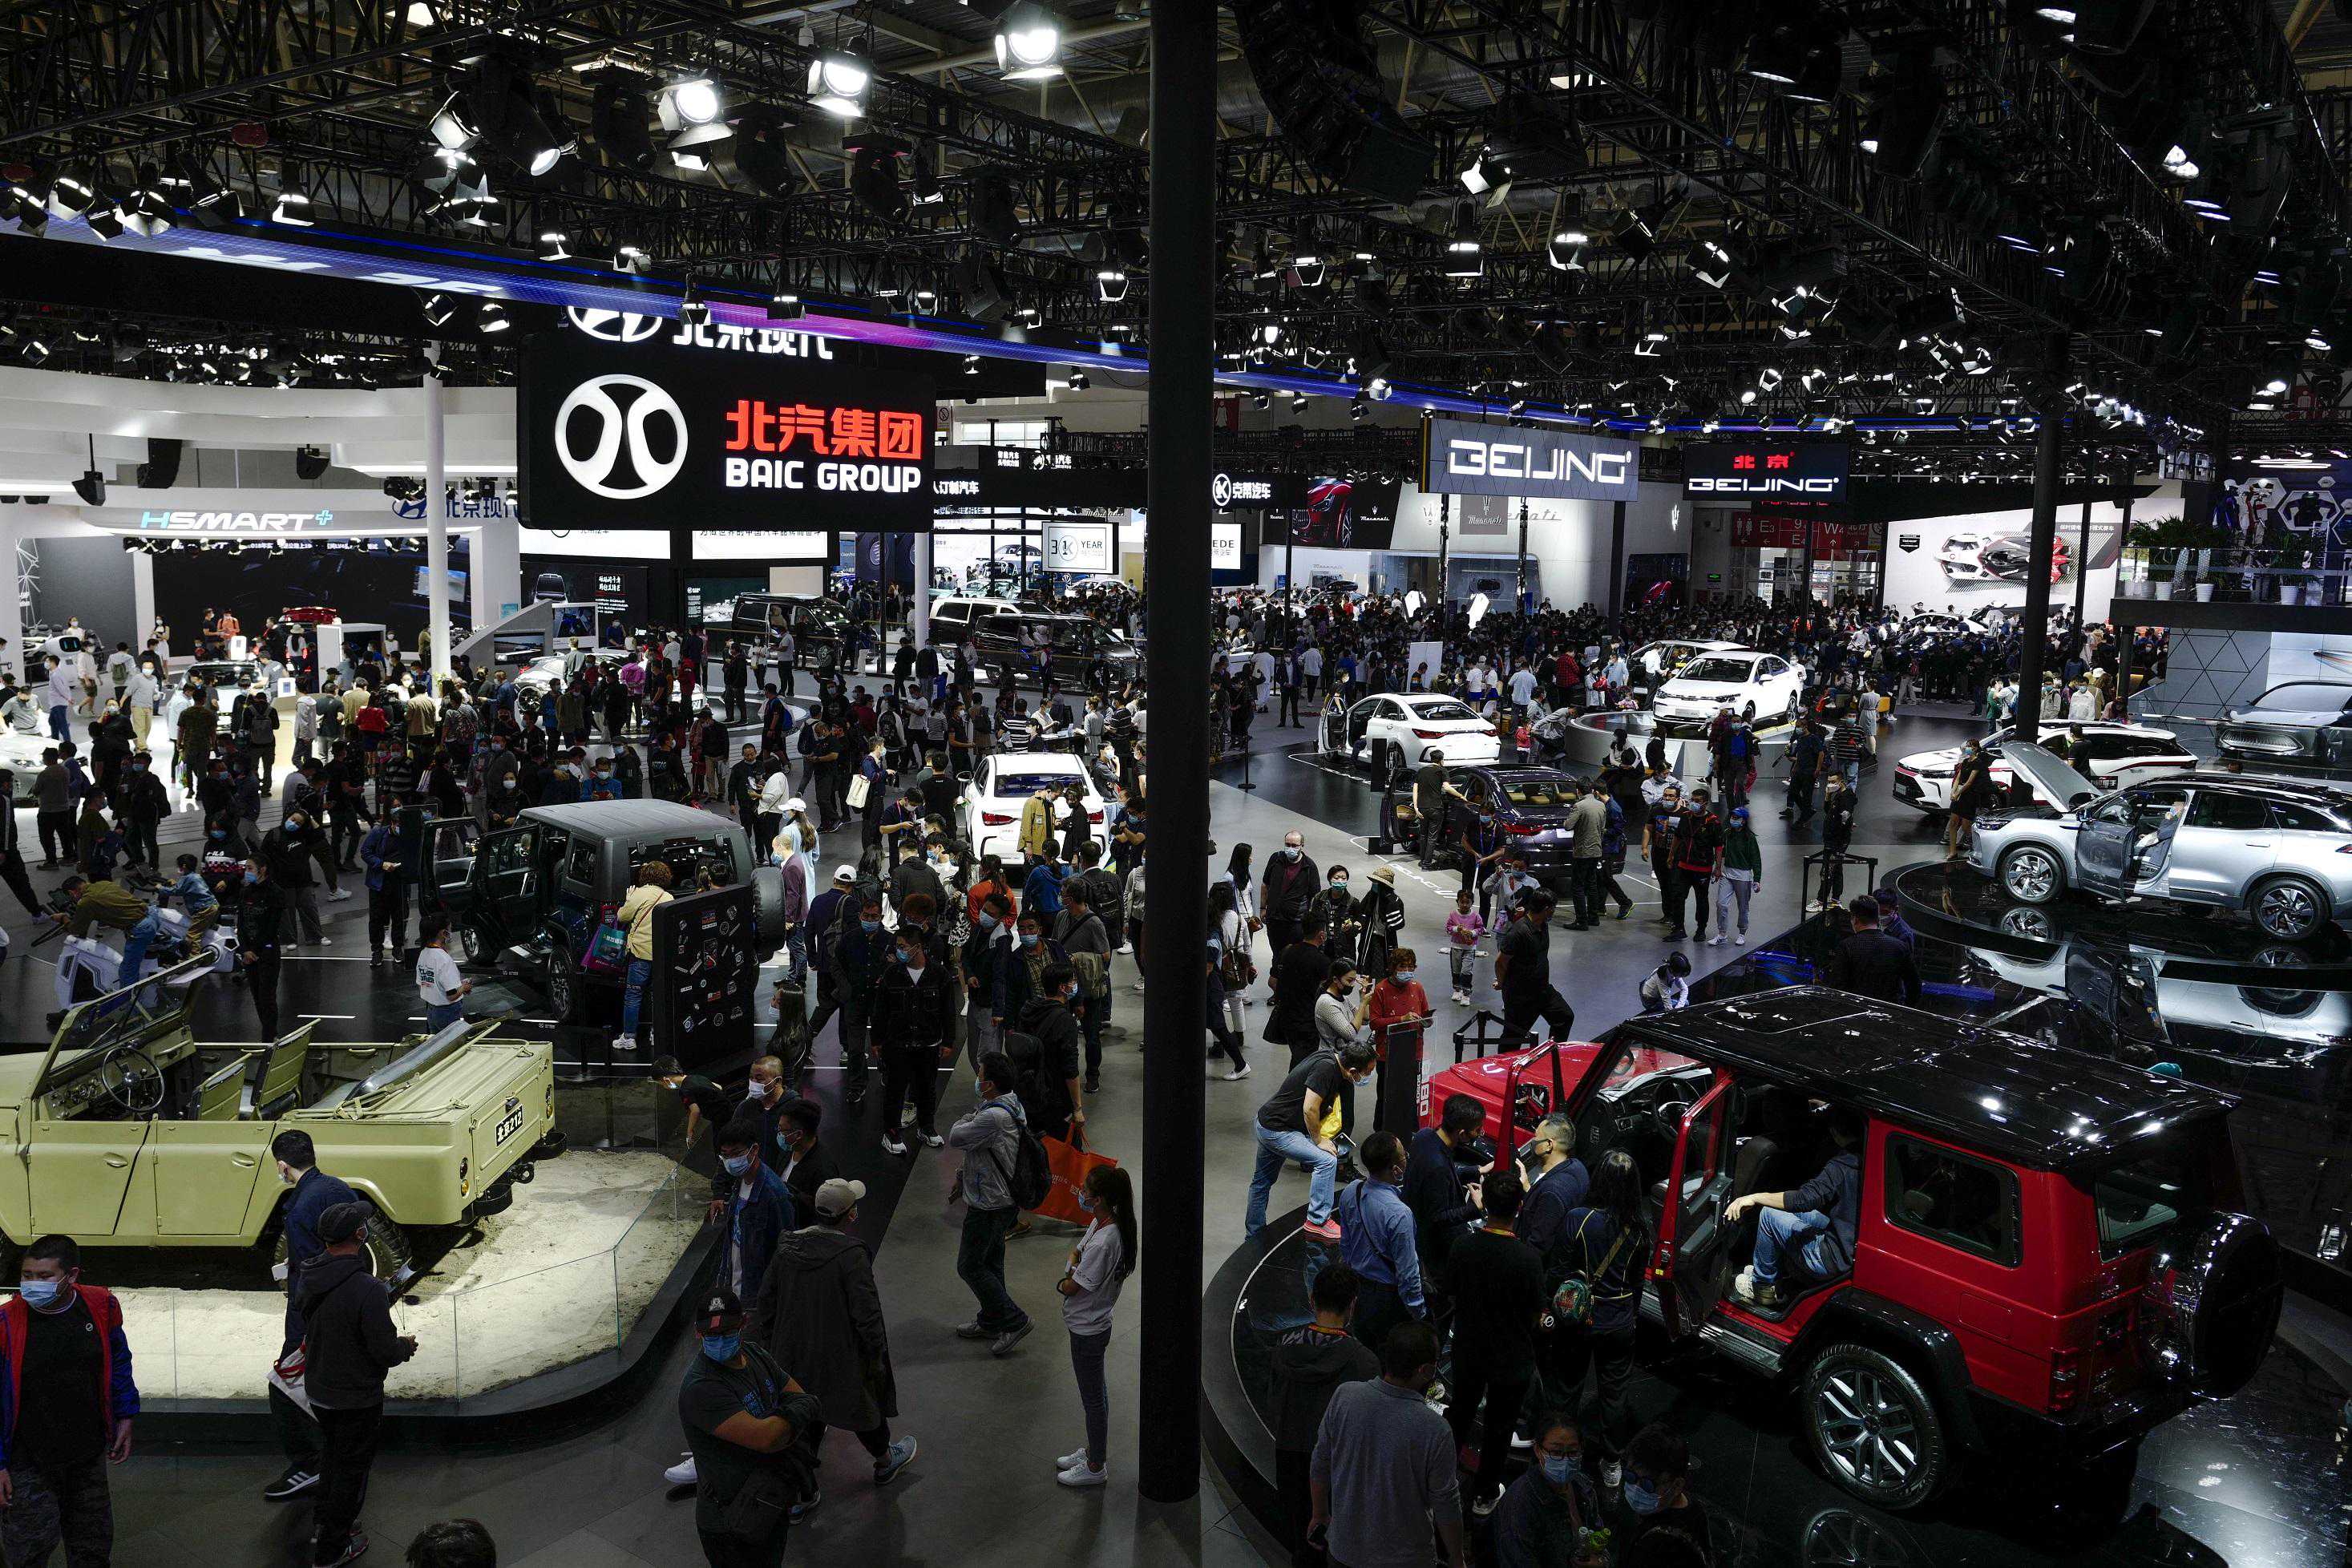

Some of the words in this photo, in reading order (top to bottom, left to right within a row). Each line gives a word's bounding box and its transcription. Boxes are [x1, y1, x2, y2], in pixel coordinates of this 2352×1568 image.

[725, 400, 922, 459] 北汽集团
[725, 458, 804, 489] BAIC
[817, 461, 921, 493] GROUP
[1449, 439, 1628, 484] BEIJING
[1733, 455, 1789, 469] 北京
[1688, 478, 1836, 492] BEIJING
[1081, 540, 1102, 549] YEAR
[497, 1110, 523, 1142] 北京212
